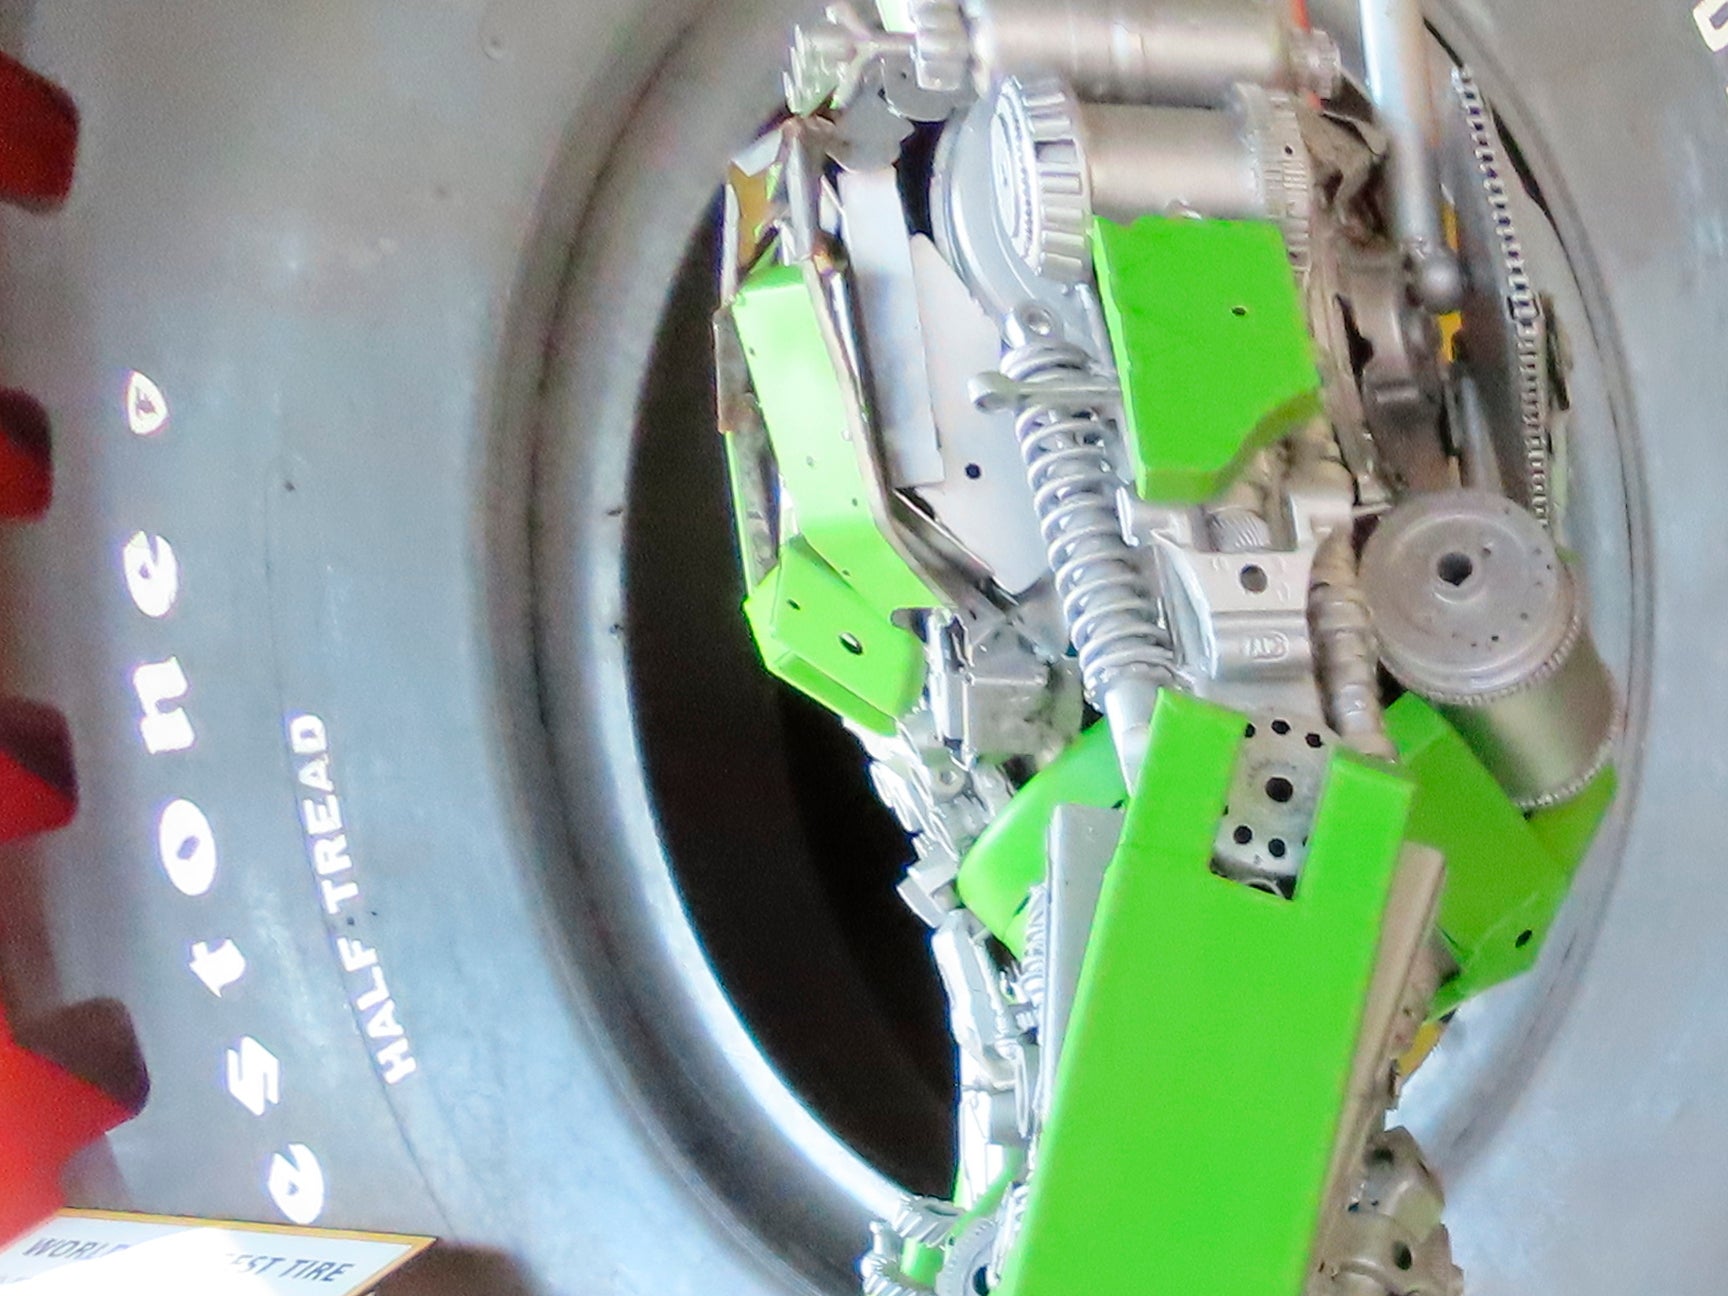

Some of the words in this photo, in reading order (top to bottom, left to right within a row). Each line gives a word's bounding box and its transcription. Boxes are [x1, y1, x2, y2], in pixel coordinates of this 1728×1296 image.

[286, 714, 360, 914] TREAD
[334, 930, 416, 1084] HALF
[279, 1259, 355, 1282] TIRE
